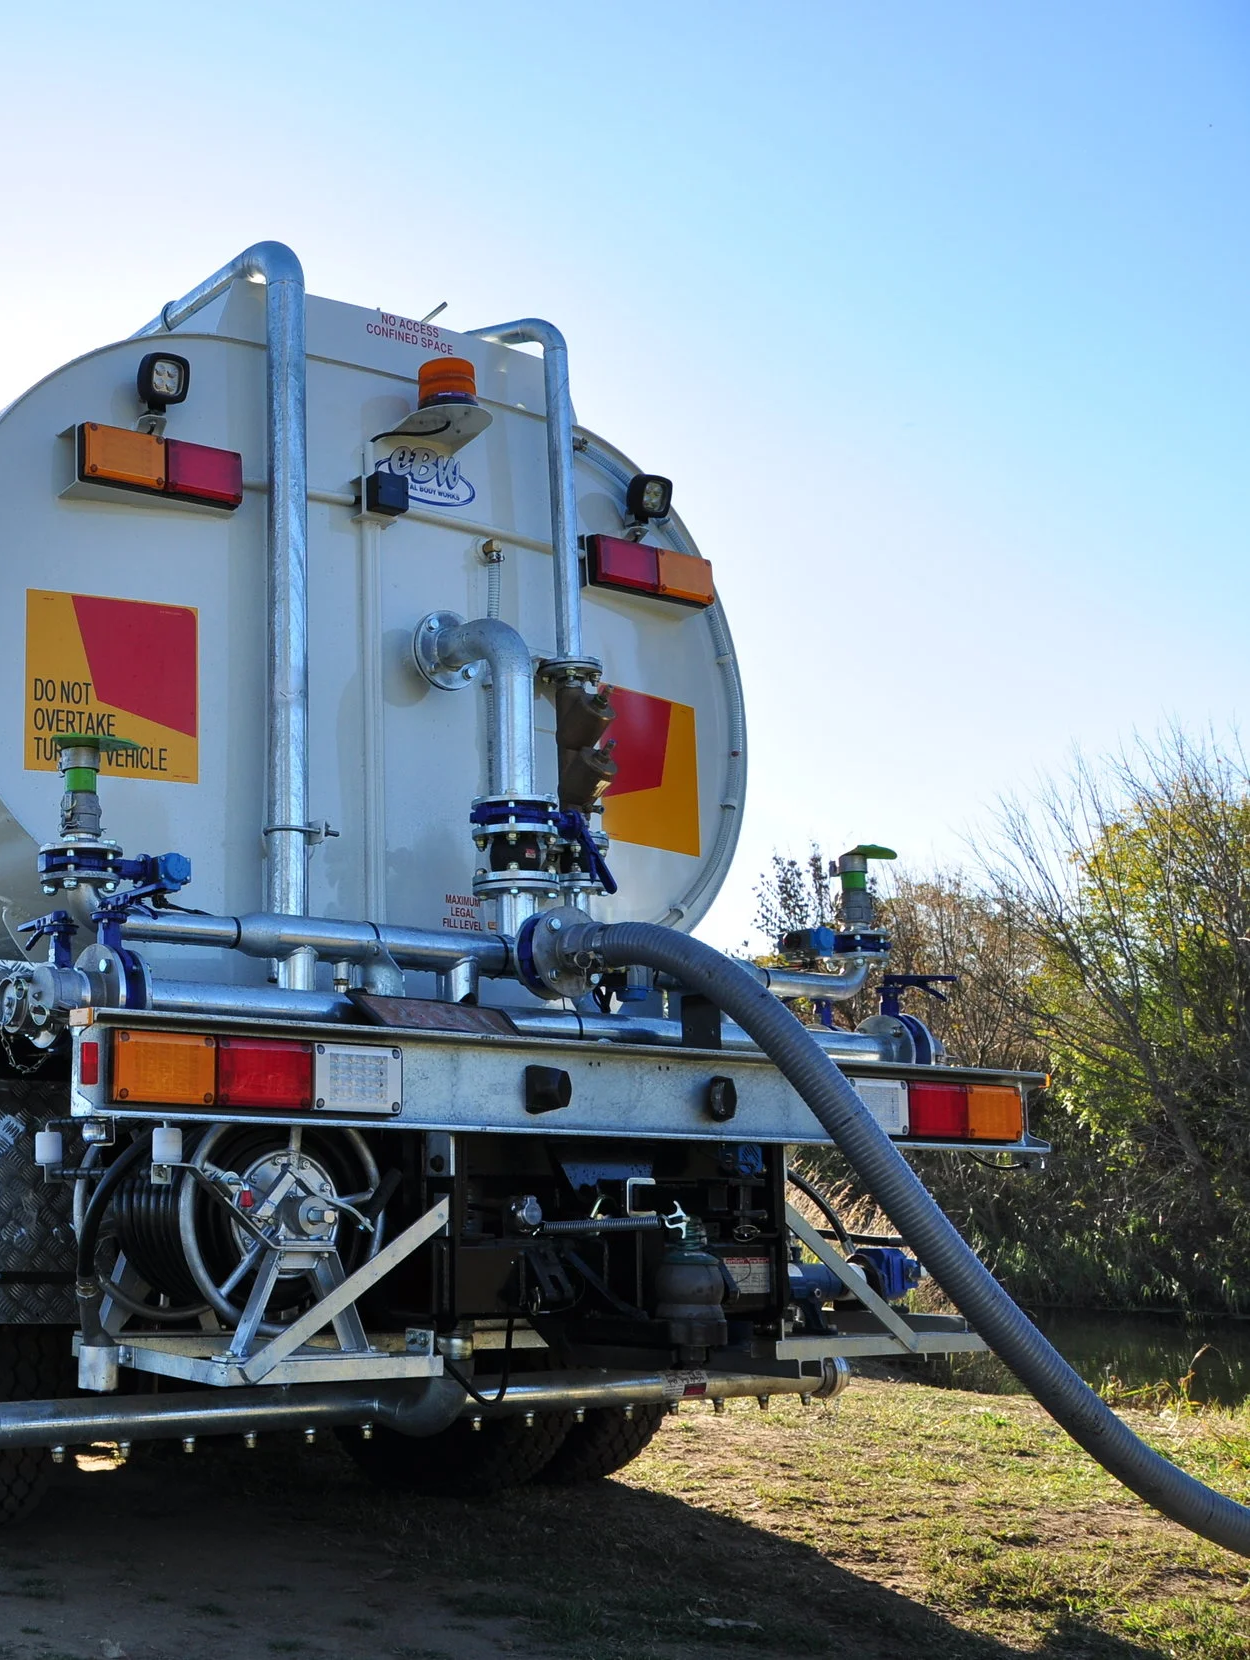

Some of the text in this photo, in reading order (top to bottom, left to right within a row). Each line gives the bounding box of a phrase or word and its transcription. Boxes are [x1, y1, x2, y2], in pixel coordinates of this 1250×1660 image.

[381, 313, 439, 338] NO ACCESS
[366, 323, 453, 355] CONFINED SPACE
[34, 678, 92, 705] DO NOT
[34, 707, 116, 737] OVERTAKE
[107, 746, 168, 771] VEHICLE
[445, 894, 481, 908] MAXIMUM
[451, 907, 475, 919] LEGAL
[443, 917, 483, 932] FILL LEVEL
